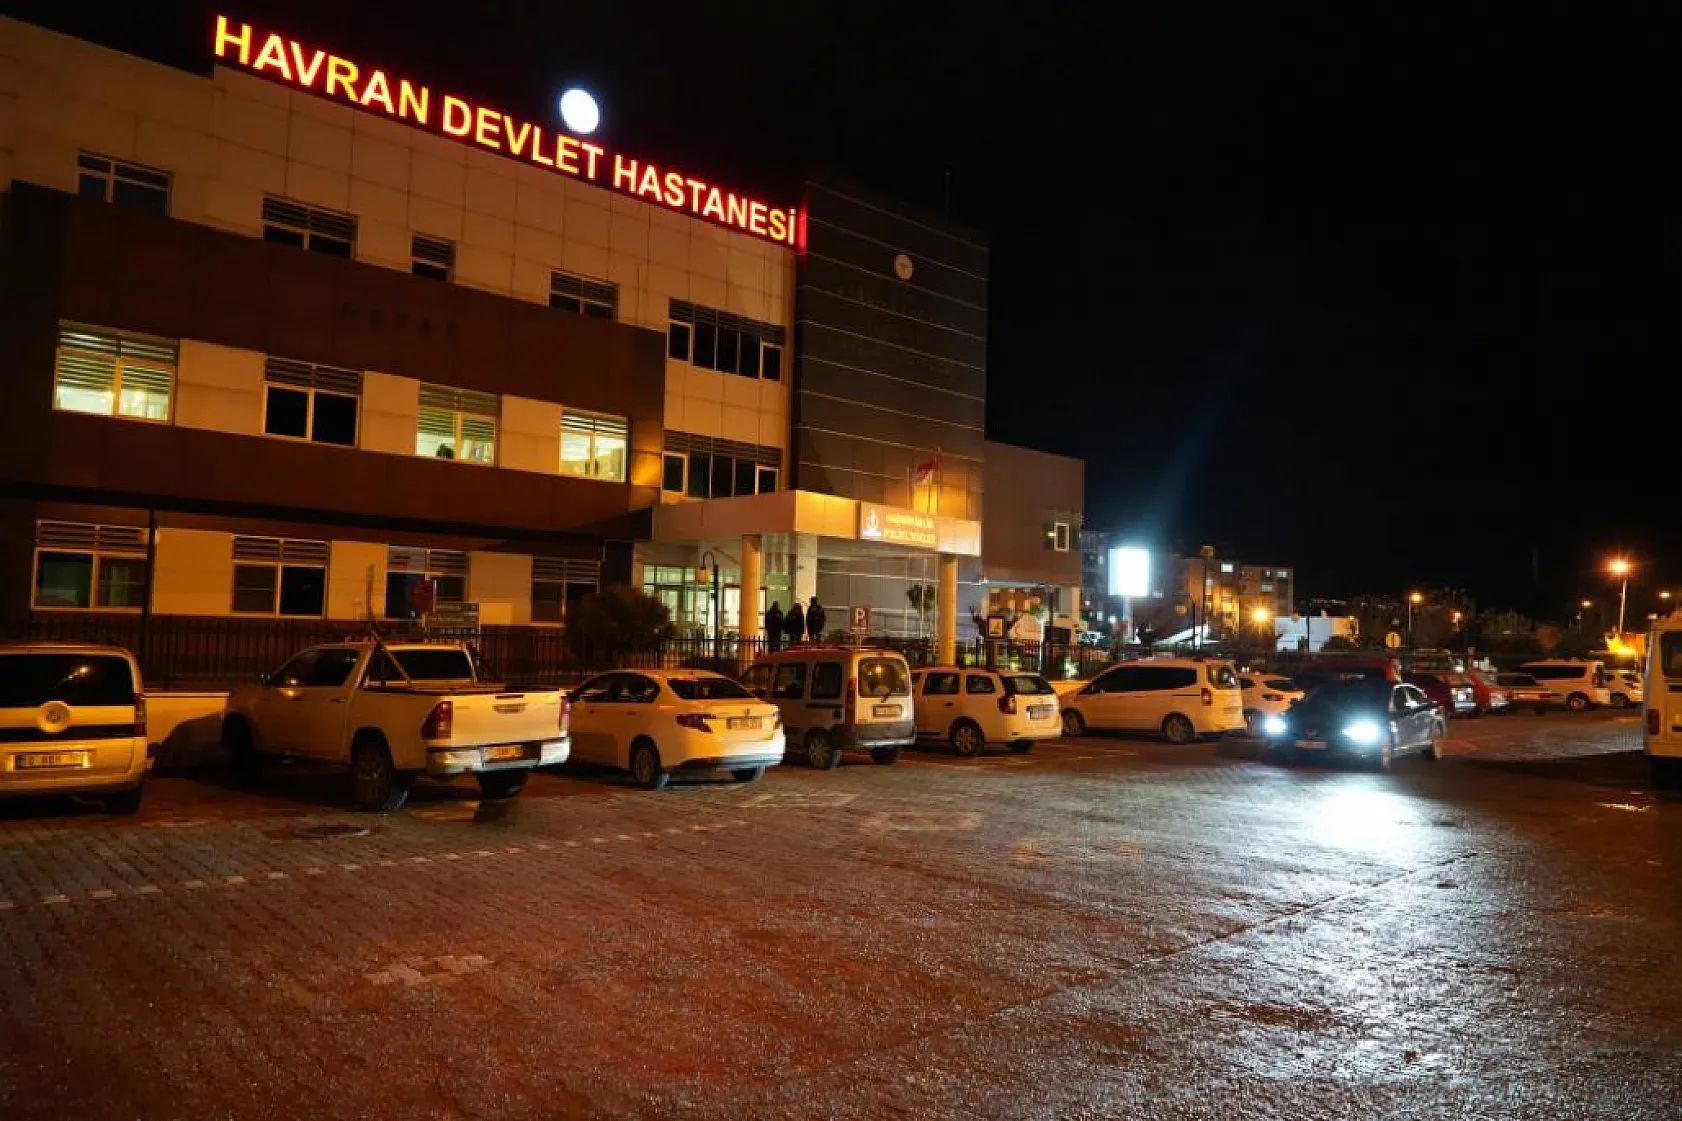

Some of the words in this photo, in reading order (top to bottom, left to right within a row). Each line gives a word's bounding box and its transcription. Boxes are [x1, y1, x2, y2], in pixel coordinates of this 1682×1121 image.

[215, 15, 430, 124] HAVRAN
[442, 95, 605, 180] DEVLET
[613, 153, 797, 245] HASTANESİ
[855, 607, 866, 625] P
